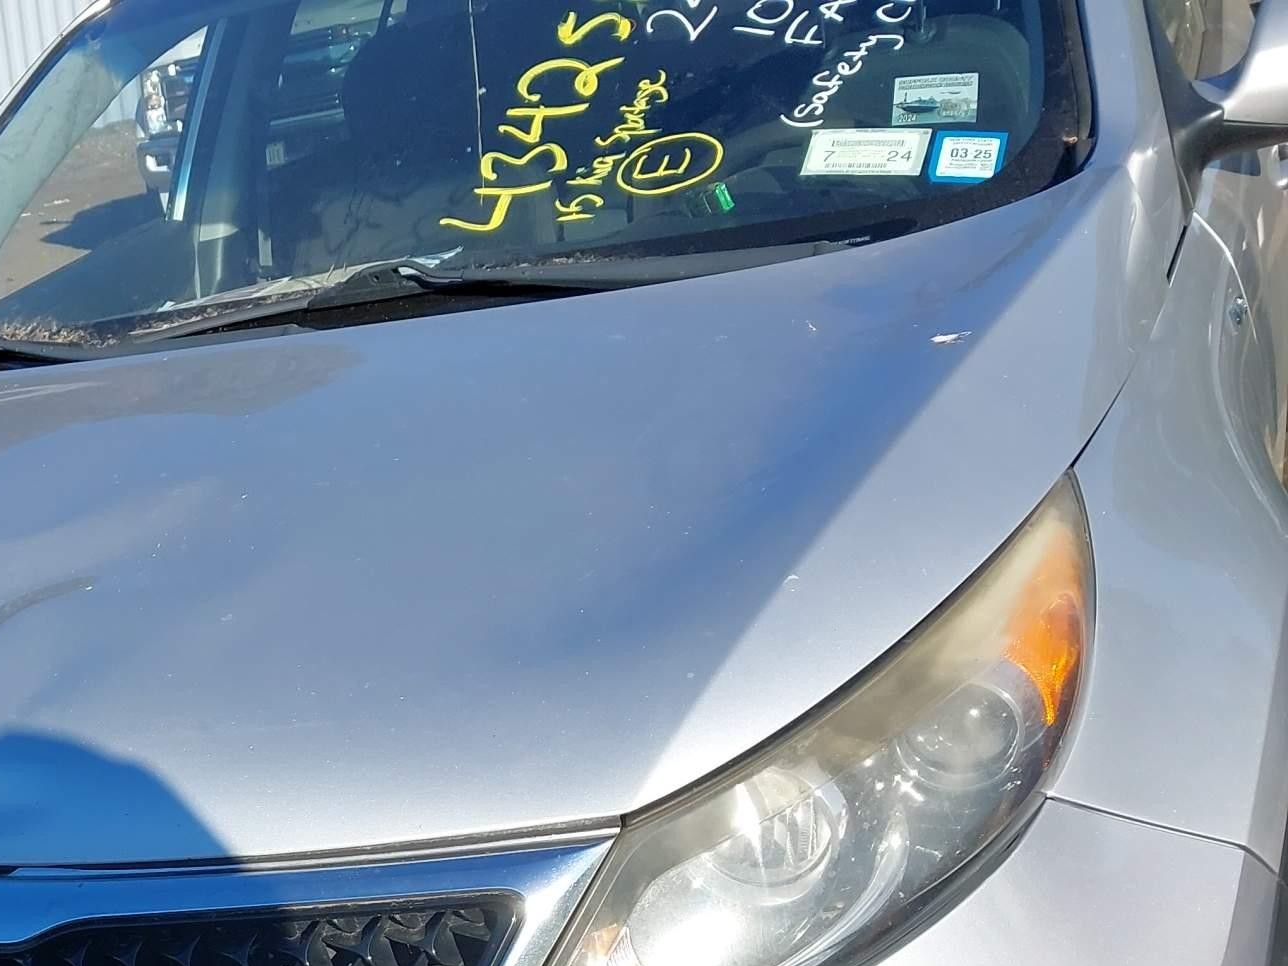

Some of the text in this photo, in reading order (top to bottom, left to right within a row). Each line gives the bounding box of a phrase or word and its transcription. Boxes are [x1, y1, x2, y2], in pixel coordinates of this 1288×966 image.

[646, 0, 718, 41] 2
[439, 0, 632, 231] 43425
[823, 150, 913, 162] 7 24
[973, 149, 993, 159] 25
